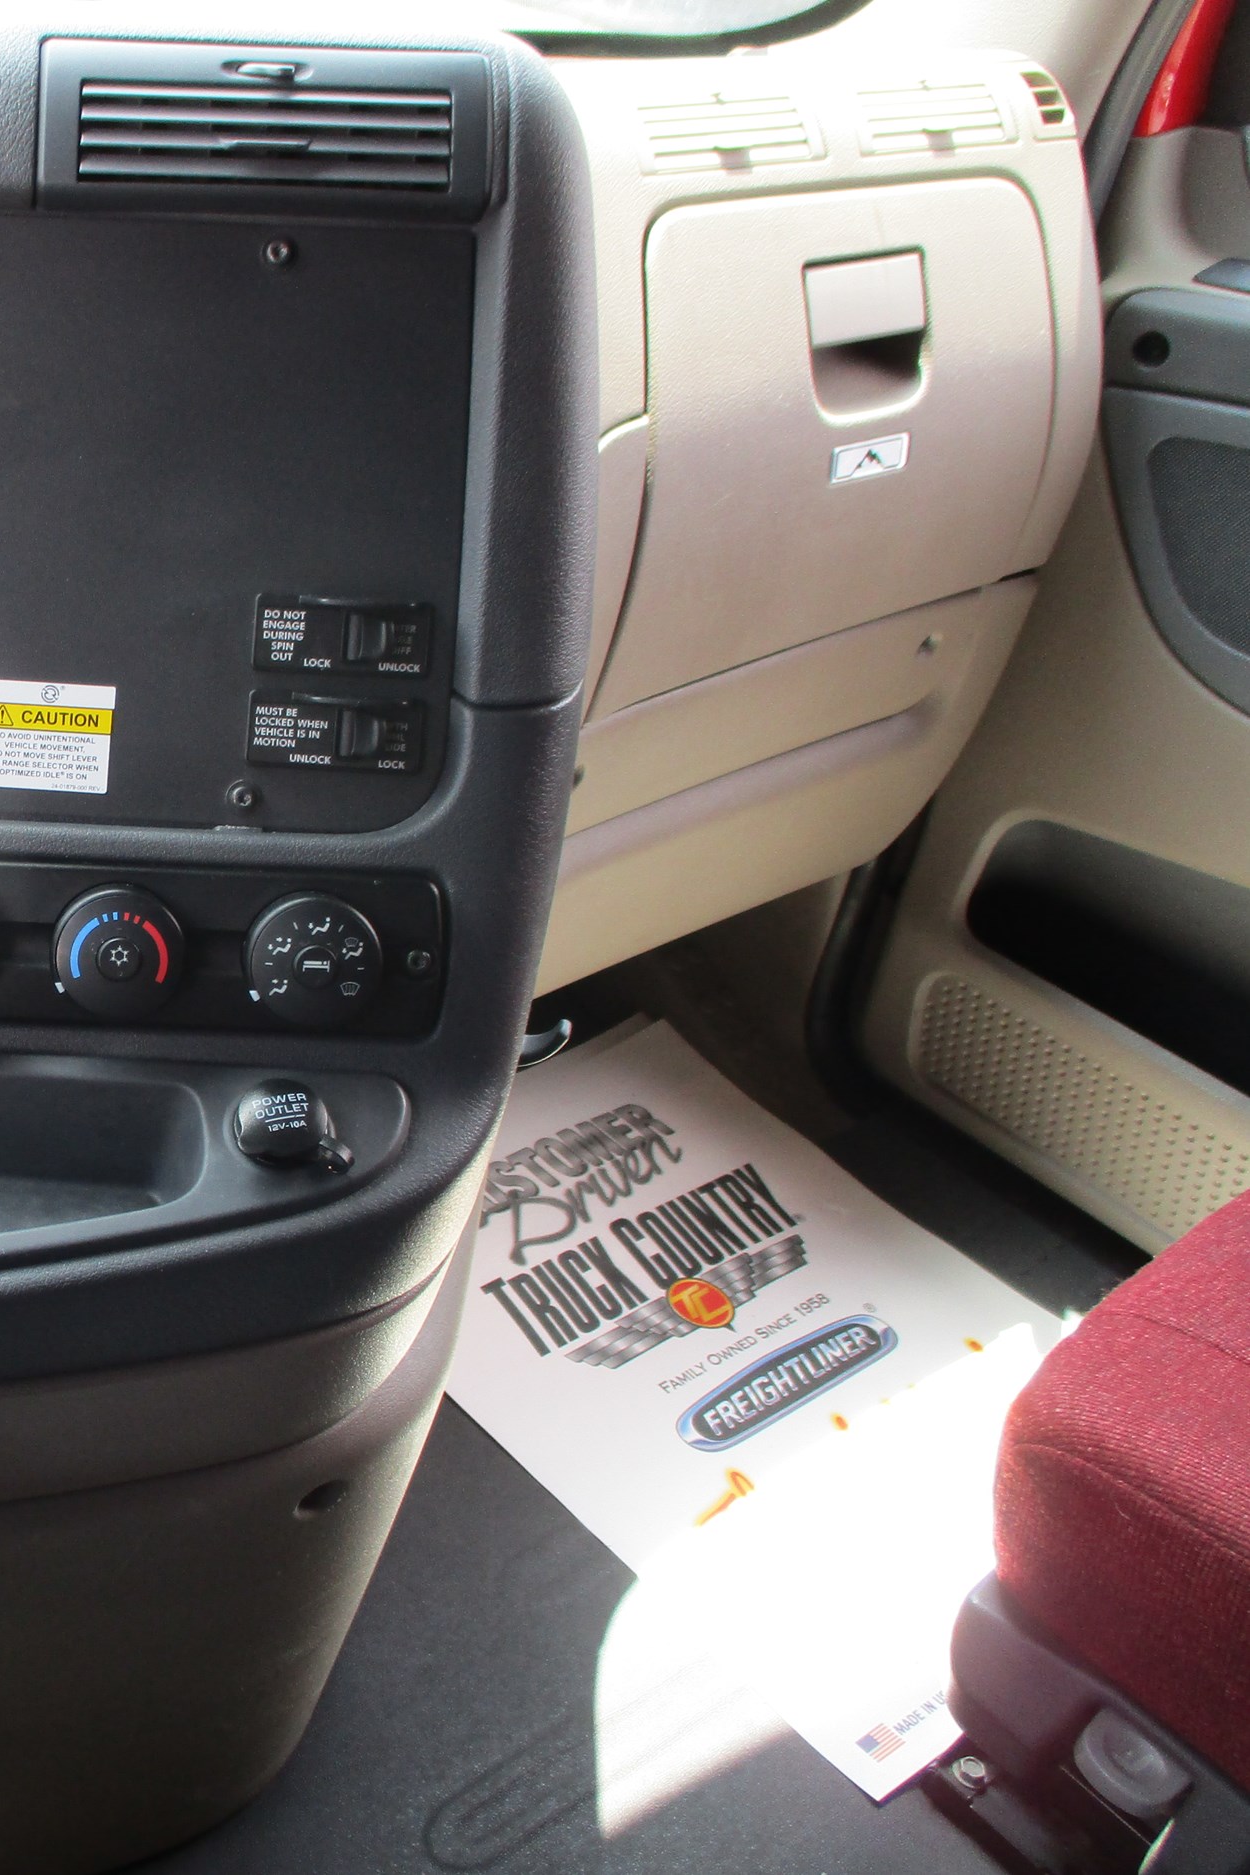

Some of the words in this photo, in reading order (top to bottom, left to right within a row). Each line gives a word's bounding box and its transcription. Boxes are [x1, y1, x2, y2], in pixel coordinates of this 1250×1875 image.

[264, 609, 280, 619] DO
[283, 610, 306, 620] NOT
[262, 620, 306, 631] ENGAGE
[263, 631, 304, 641] DURING
[271, 641, 294, 651] SPIN
[271, 652, 293, 661] OUT
[303, 657, 331, 668] LOCK
[378, 662, 420, 673] UNLOCK
[255, 706, 283, 716] MUST
[286, 708, 298, 717] BE
[21, 709, 100, 728] CAUTION
[254, 716, 295, 727] LOCKED
[297, 719, 329, 729] WHEN
[7, 732, 32, 740] AVOID
[33, 734, 96, 744] UNINTENTIONAL
[254, 727, 294, 738] VEHICLE
[297, 729, 306, 738] IS
[308, 730, 320, 739] IN
[4, 742, 38, 750] VEHICLE
[39, 744, 86, 753] MOVEMENT,
[253, 737, 296, 748] MOTION
[23, 751, 46, 759] MOVE
[48, 752, 70, 761] SHIFT
[72, 754, 98, 763] LEVER
[289, 754, 331, 765] UNLOCK
[2, 759, 30, 768] RANGE
[32, 761, 74, 771] SELECTOR
[75, 763, 99, 772] WHEN
[378, 760, 405, 770] LOCK
[0, 768, 41, 778] OPTIMIZED
[66, 772, 74, 780] IS
[75, 773, 87, 781] ON
[251, 1092, 307, 1109] POWER
[254, 1103, 309, 1119] OUTLET
[480, 1236, 650, 1358] TRUCK
[669, 1283, 731, 1325] TC
[794, 1293, 831, 1318] 1958
[703, 1326, 877, 1437] FREIGHTLINER
[892, 1708, 926, 1736] MADE
[921, 1699, 938, 1715] IN
